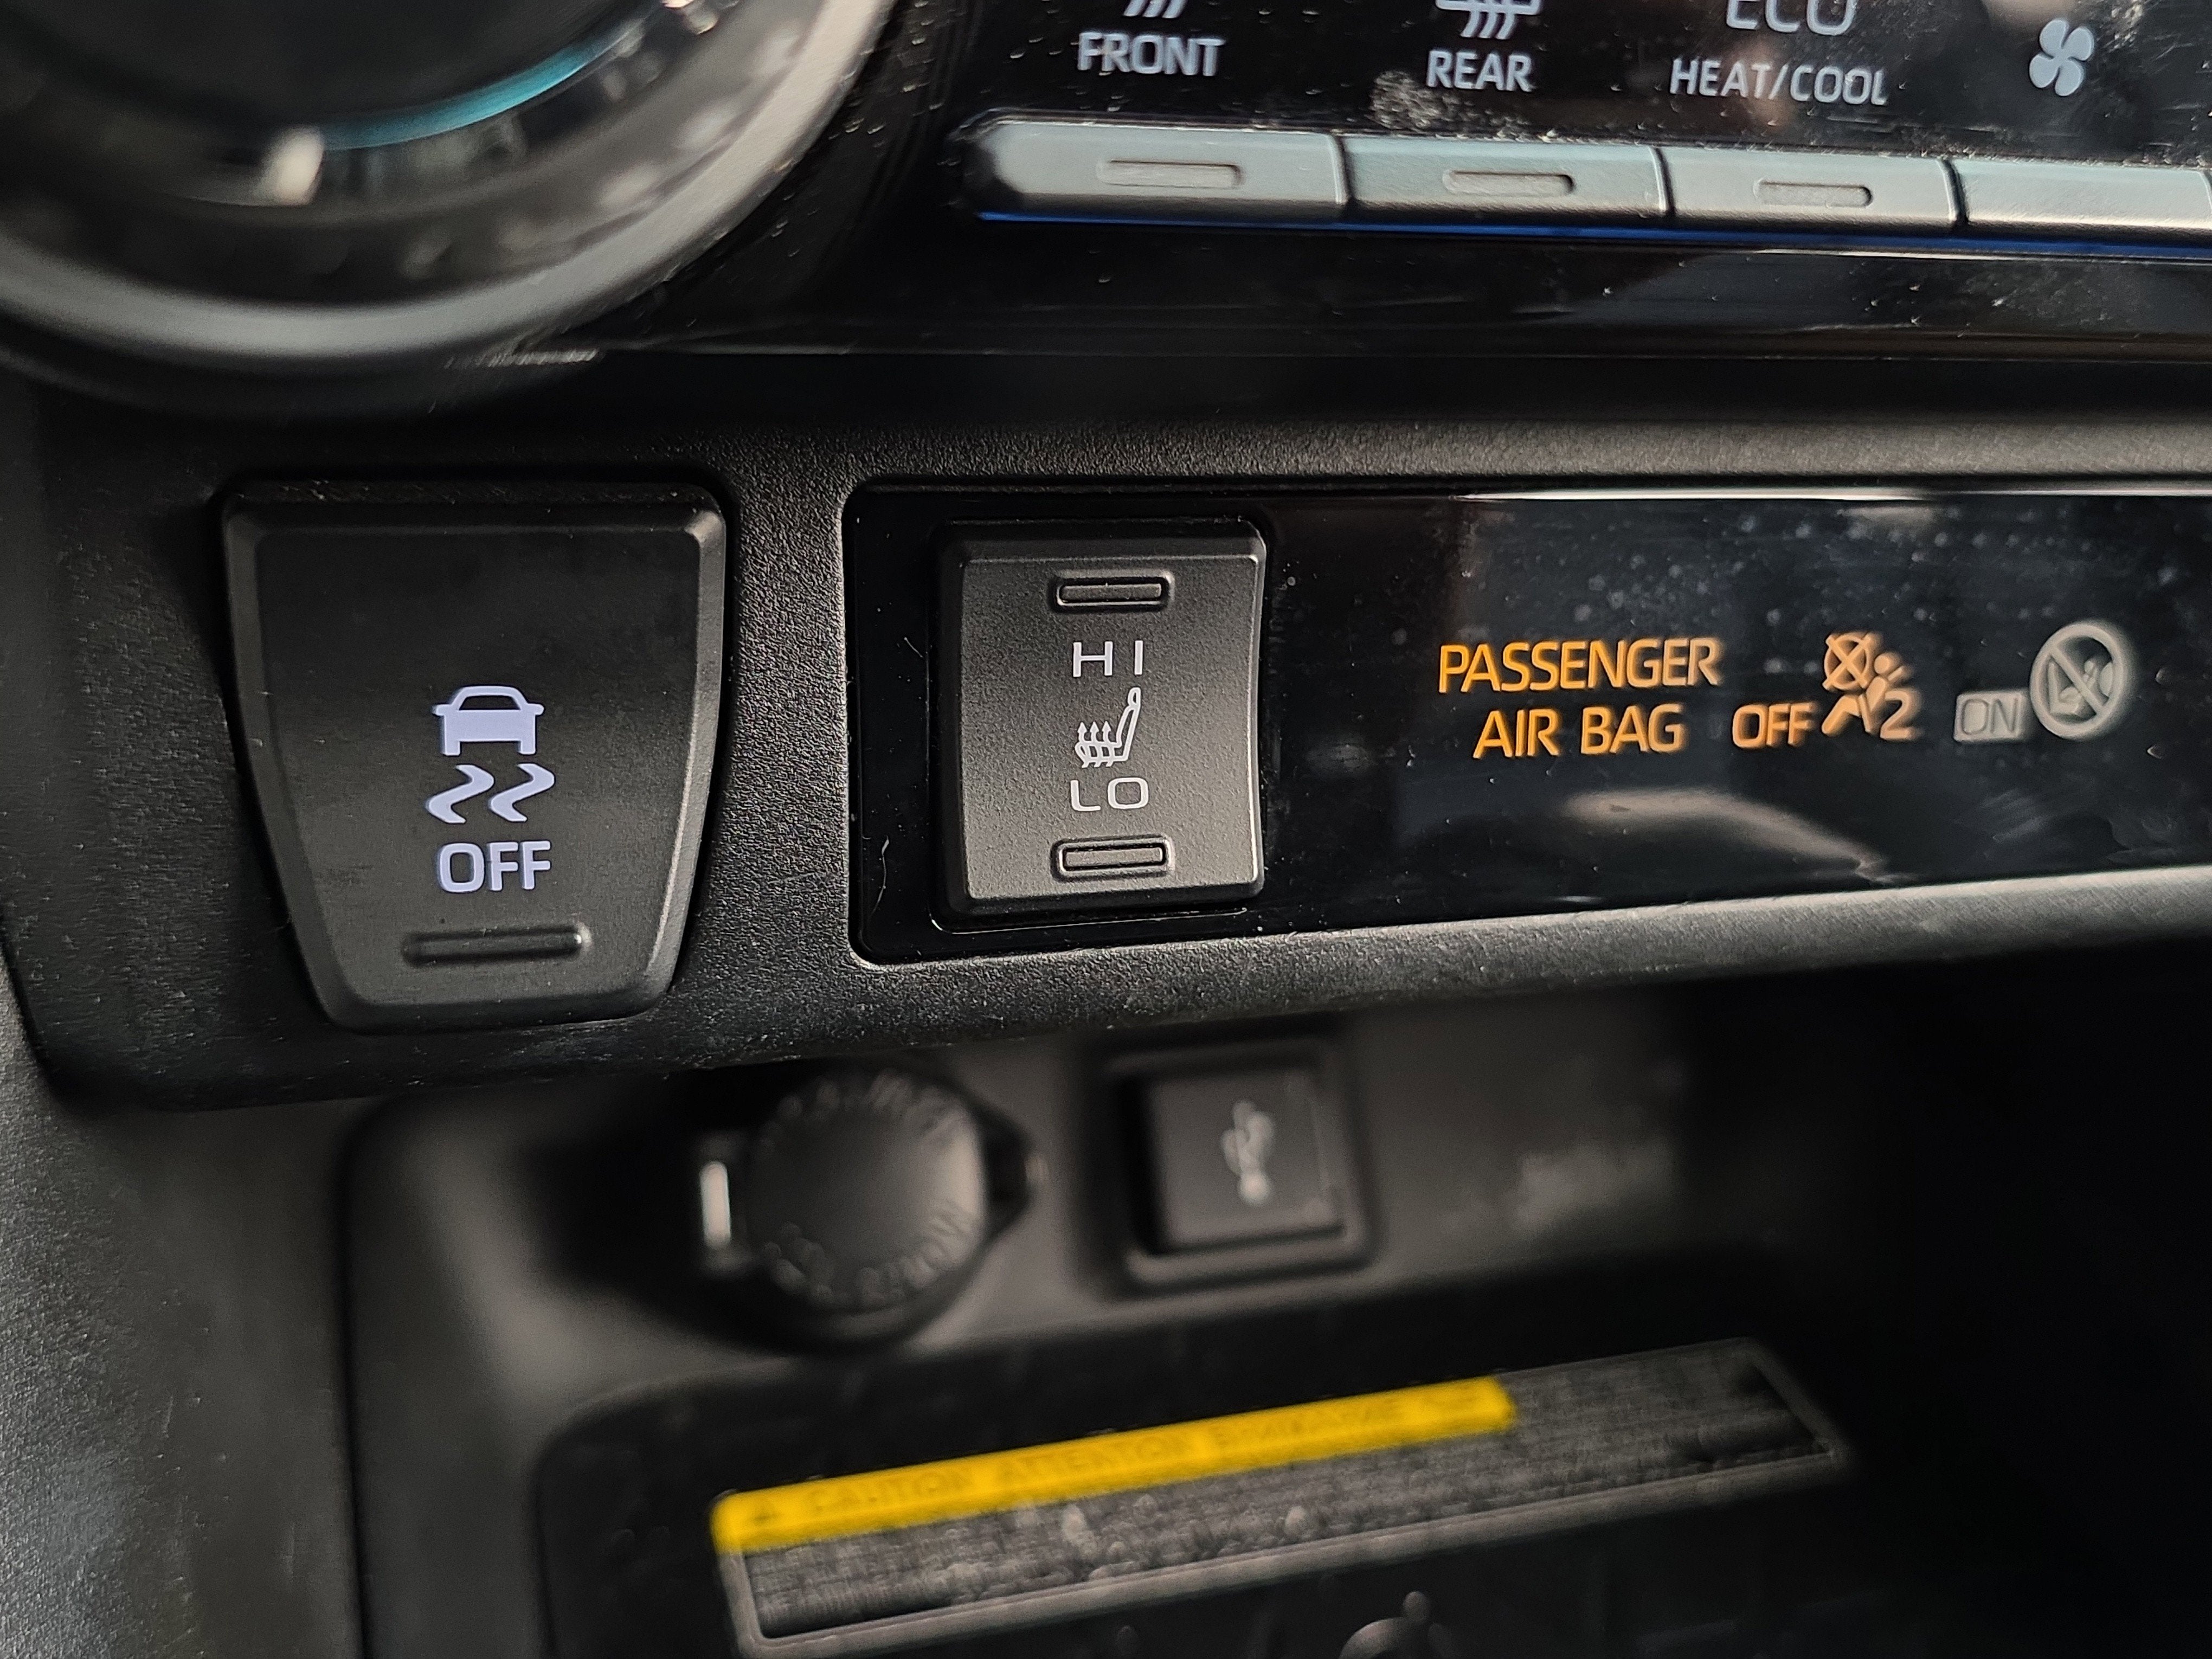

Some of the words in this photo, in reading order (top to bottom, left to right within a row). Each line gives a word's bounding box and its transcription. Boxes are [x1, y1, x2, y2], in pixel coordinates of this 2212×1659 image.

[1726, 0, 1857, 35] ECO
[1077, 30, 1226, 77] FRONT
[1426, 49, 1533, 92] REAR
[1670, 57, 1888, 106] HEAT/COOL
[1072, 640, 1143, 678] HI
[1438, 638, 1724, 693] PASSENGER
[1472, 708, 1562, 760] AIR
[1580, 703, 1686, 756] BAG
[1732, 701, 1816, 749] OFF
[1960, 697, 2020, 736] ON
[1070, 777, 1149, 812] LO
[436, 840, 551, 893] OFF
